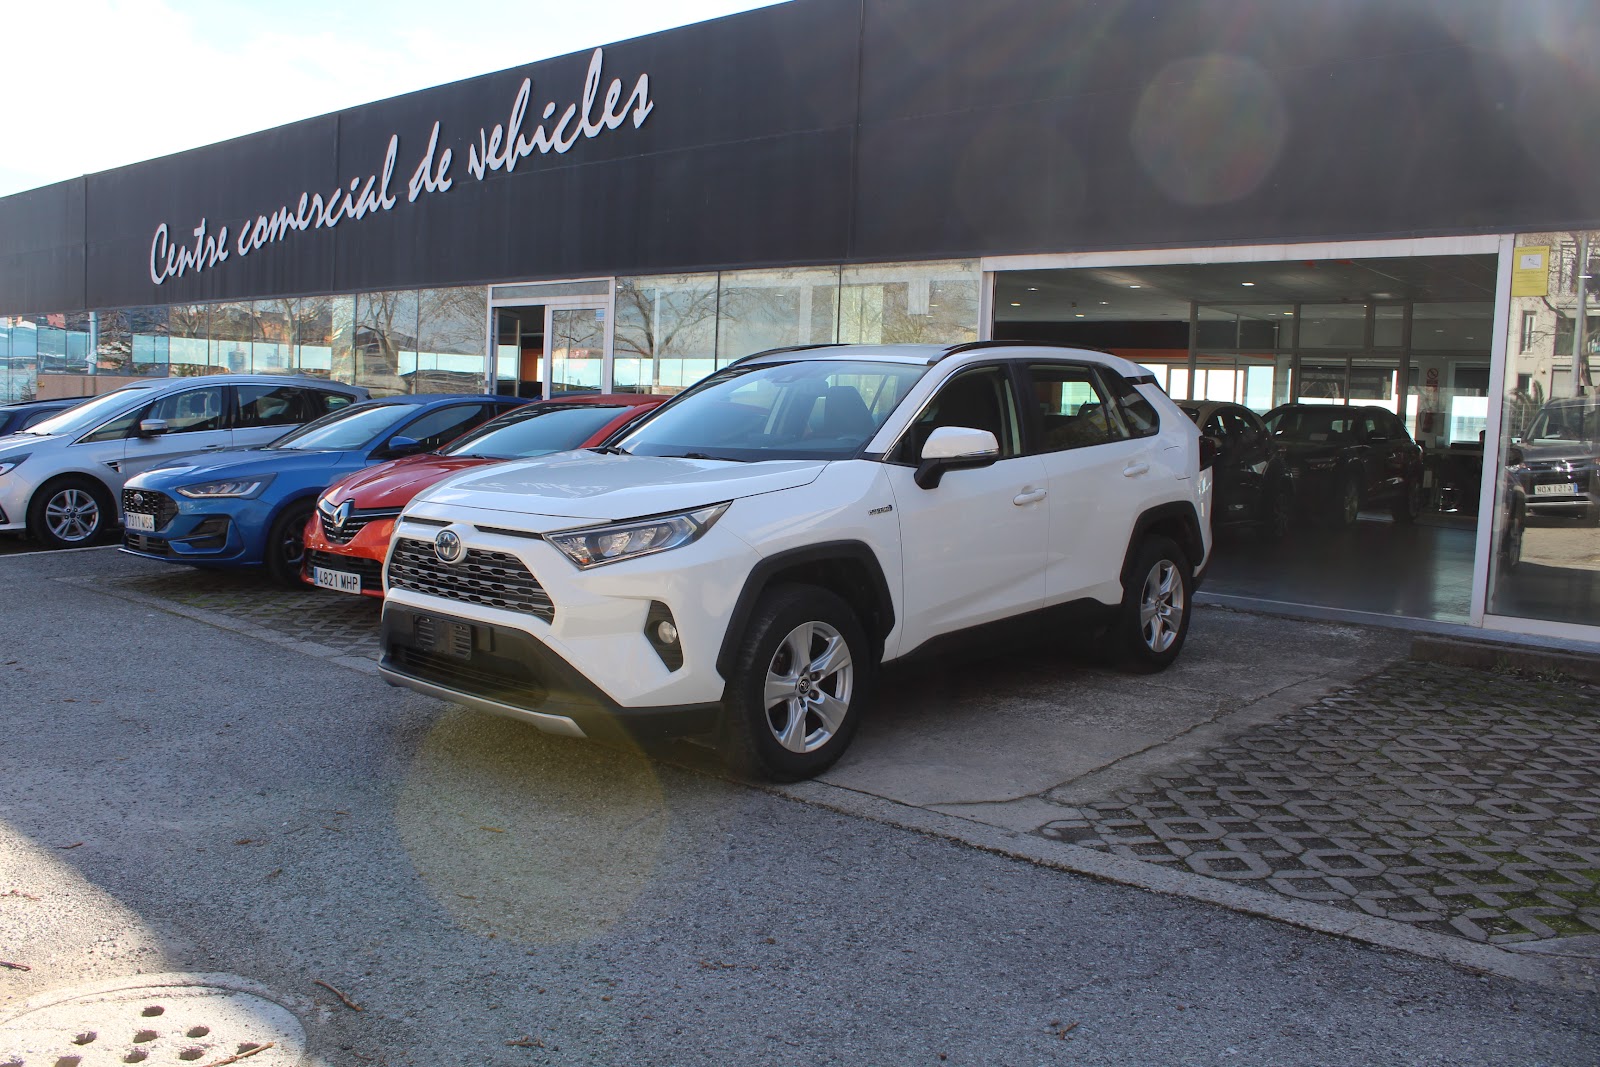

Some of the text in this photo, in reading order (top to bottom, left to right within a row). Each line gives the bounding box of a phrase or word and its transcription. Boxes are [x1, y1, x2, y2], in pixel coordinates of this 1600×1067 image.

[150, 47, 654, 285] Centre comercial de vehicles
[319, 570, 358, 591] 4821 MHP
